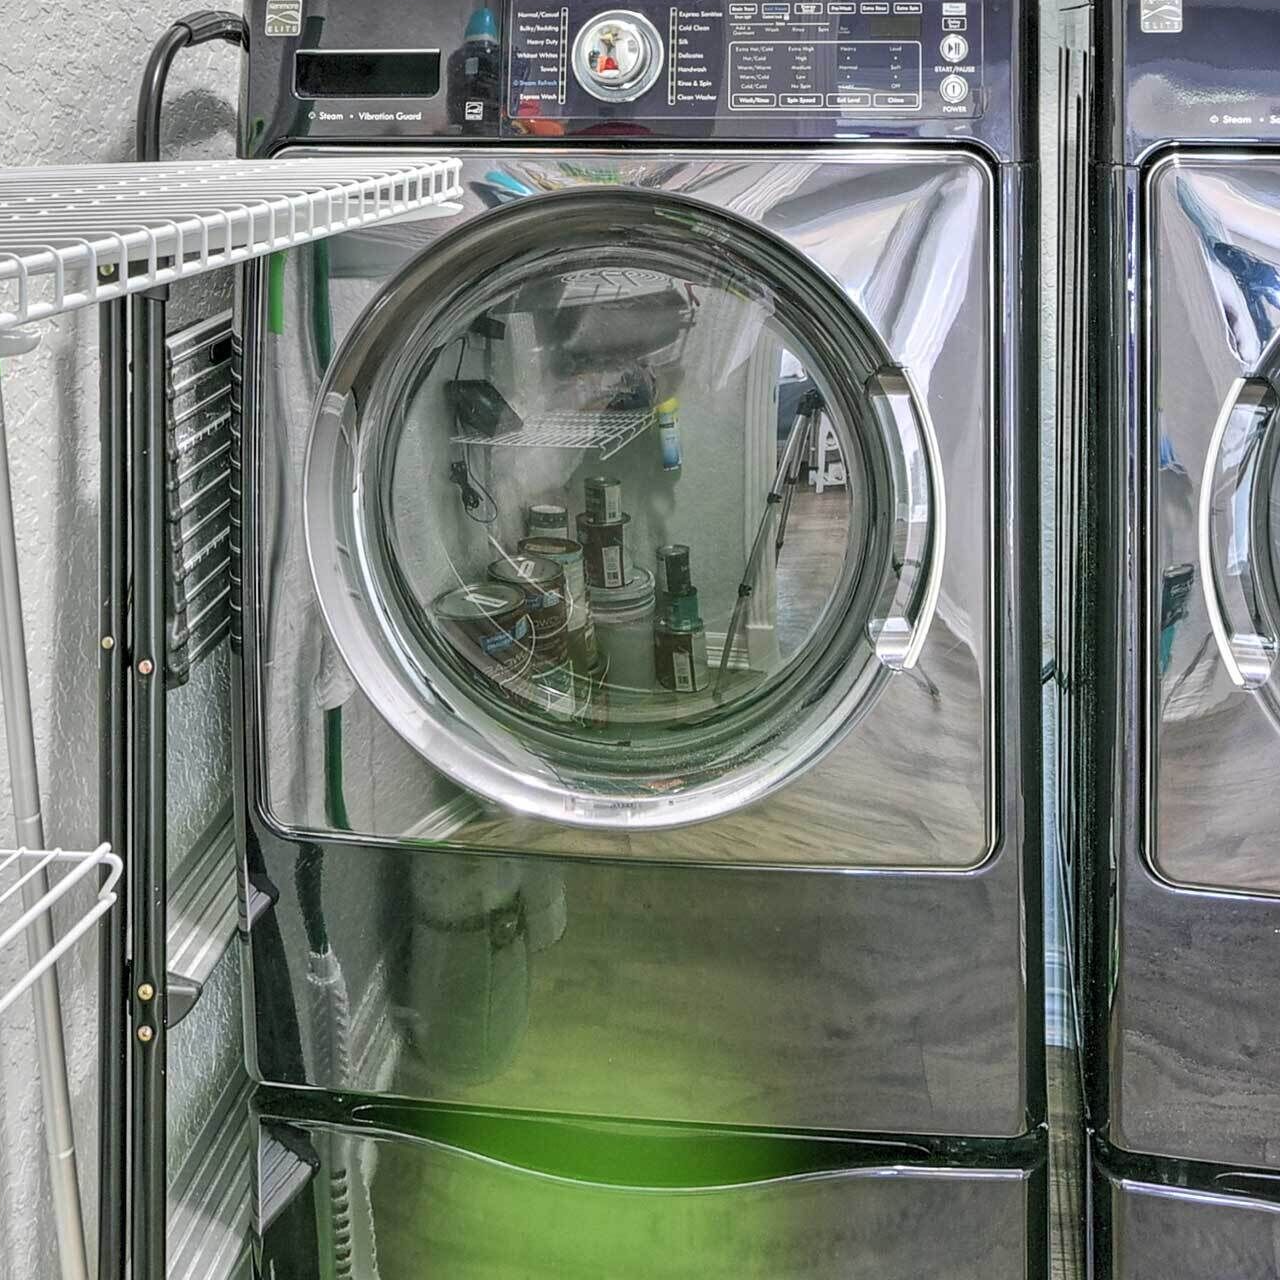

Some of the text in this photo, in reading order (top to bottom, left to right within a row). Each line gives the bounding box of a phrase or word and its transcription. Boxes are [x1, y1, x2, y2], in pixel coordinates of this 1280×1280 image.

[268, 25, 297, 33] ELITE
[319, 111, 422, 120] Steam Vibration Guard
[1222, 114, 1252, 124] Steam
